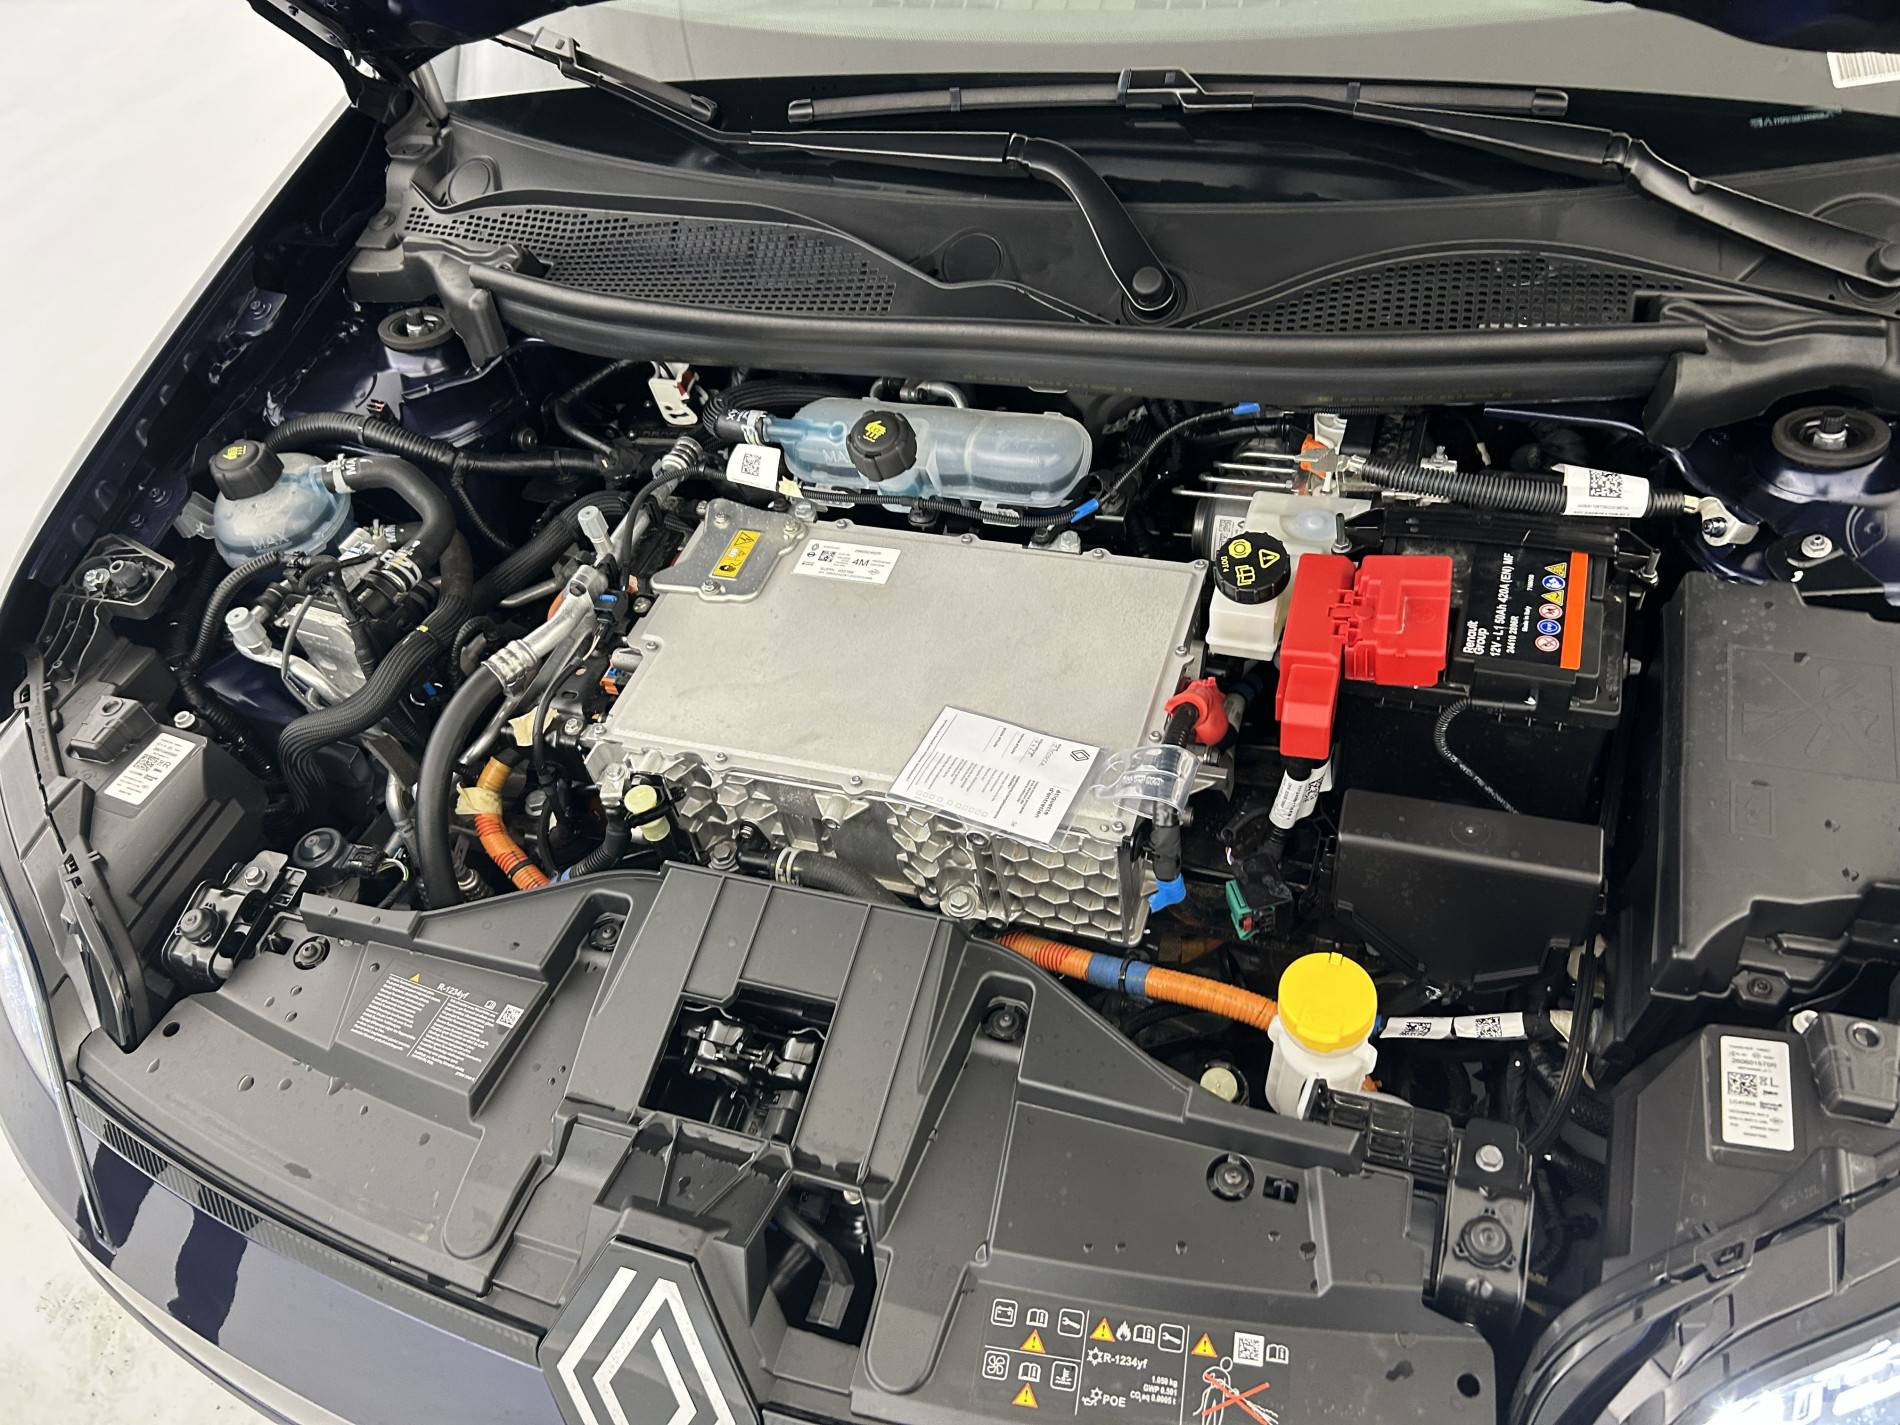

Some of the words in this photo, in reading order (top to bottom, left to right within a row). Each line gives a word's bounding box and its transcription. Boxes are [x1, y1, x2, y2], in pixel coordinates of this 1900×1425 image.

[823, 449, 852, 464] MA
[852, 558, 870, 567] 4M
[1221, 556, 1229, 568] DOT
[1503, 552, 1514, 565] MF
[1500, 566, 1515, 584] (EN)
[1498, 585, 1510, 603] 420A
[1495, 604, 1507, 625] 50Ah
[1493, 622, 1504, 636] L1
[1463, 620, 1479, 654] Renault
[1474, 628, 1489, 655] Group
[1490, 642, 1502, 656] 12V
[436, 983, 470, 1000] R-1234yf
[1103, 1353, 1148, 1370] R-1234yf
[1143, 1384, 1160, 1393] GWP
[1169, 1378, 1178, 1388] kg
[1102, 1394, 1126, 1408] POE
